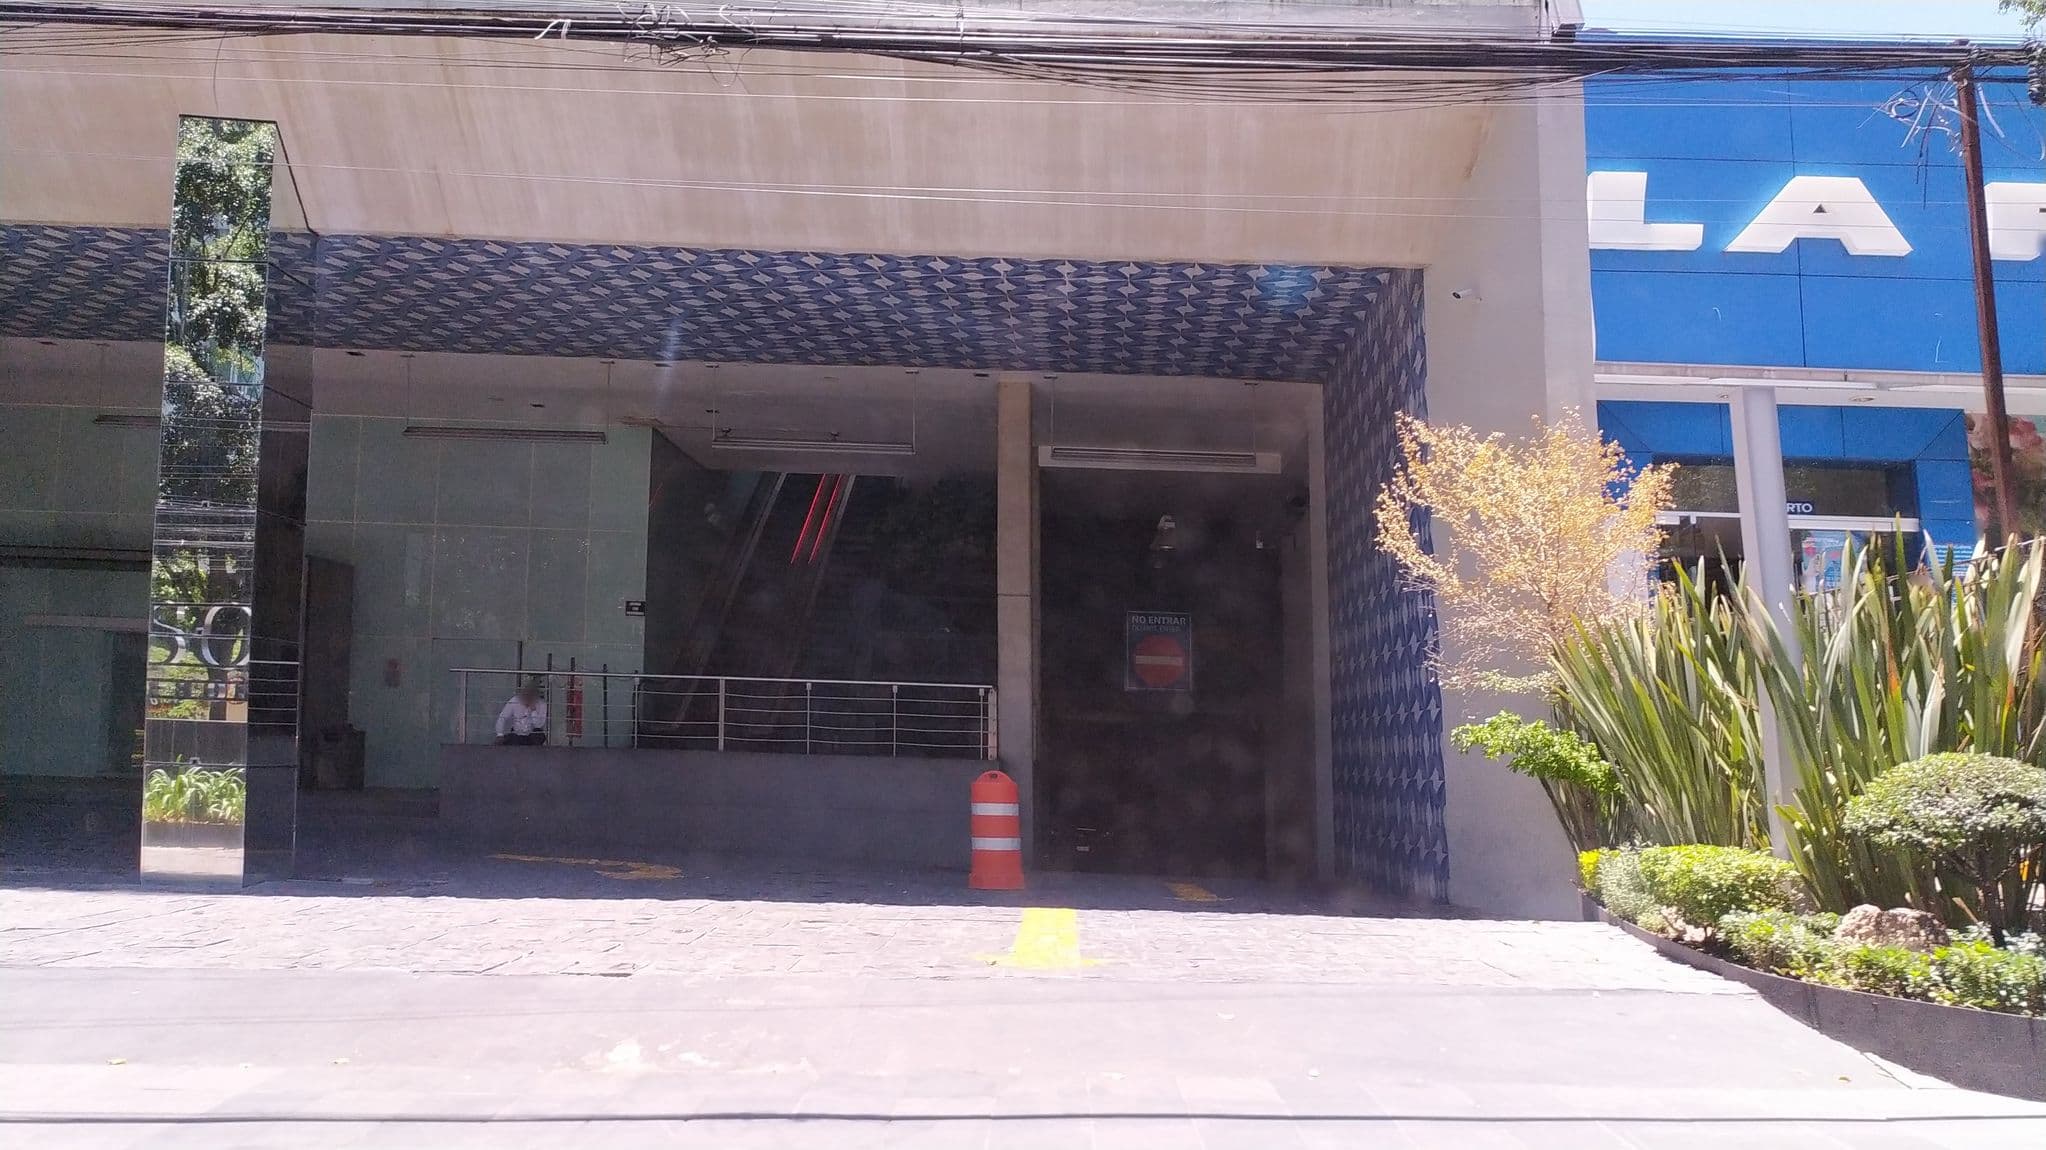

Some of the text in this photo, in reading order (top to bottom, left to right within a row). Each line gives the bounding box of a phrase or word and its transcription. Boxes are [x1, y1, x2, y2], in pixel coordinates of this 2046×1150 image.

[1786, 502, 1813, 513] RTO
[1131, 615, 1186, 625] NO ENTRAR
